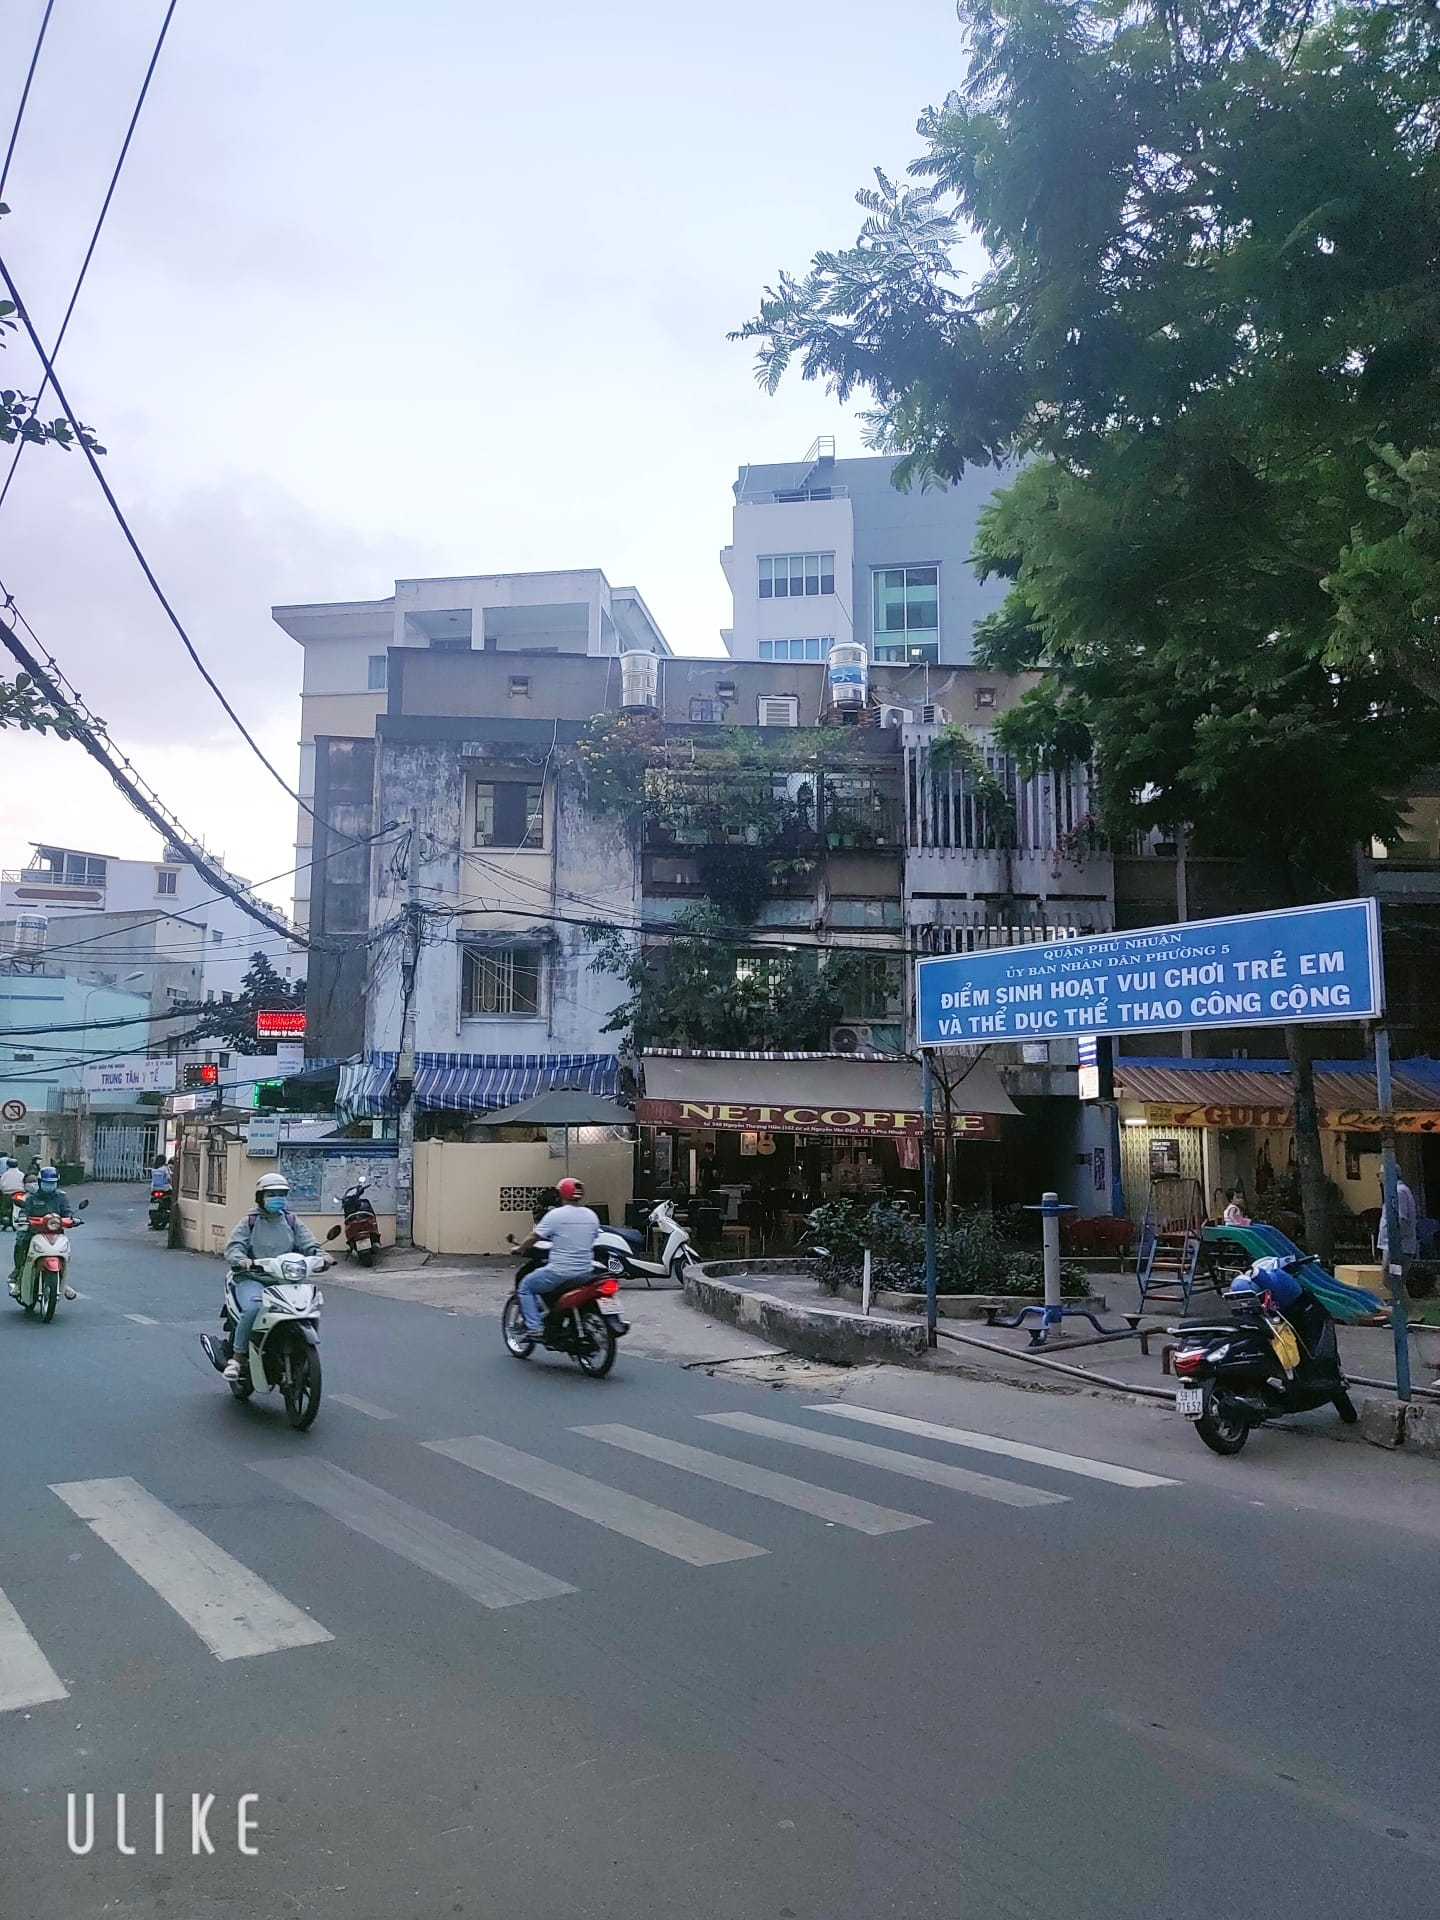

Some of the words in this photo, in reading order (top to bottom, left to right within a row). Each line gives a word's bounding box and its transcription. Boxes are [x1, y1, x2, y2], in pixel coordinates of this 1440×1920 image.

[1006, 965, 1025, 978] ỦY
[1029, 965, 1057, 976] BAN
[1061, 958, 1102, 972] NHÂN
[1108, 954, 1141, 968] DÂN
[1145, 945, 1216, 963] PHƯỜNG
[1221, 945, 1230, 954] 5
[1044, 944, 1084, 960] QUẬN
[1088, 939, 1120, 955] PHÚ
[1125, 934, 1182, 950] NHUẬN
[941, 982, 990, 1009] ĐIỂM
[996, 983, 1043, 1004] SINH
[1050, 976, 1109, 1000] HOẠT
[1117, 972, 1156, 992] VUI
[1164, 962, 1224, 988] CHƠI
[1233, 950, 1287, 981] TRẺ
[1300, 951, 1344, 975] EM
[939, 1014, 962, 1036] VÀ
[968, 1006, 1007, 1033] THỂ
[1015, 1010, 1058, 1033] DỤC
[1064, 997, 1109, 1026] THỂ
[1117, 999, 1182, 1022] THAO
[1190, 991, 1261, 1017] CÔNG
[1270, 983, 1350, 1014] CỘNG
[101, 1072, 122, 1085] TRUNG
[126, 1069, 140, 1084] TÂM
[149, 1066, 159, 1083] TẾ
